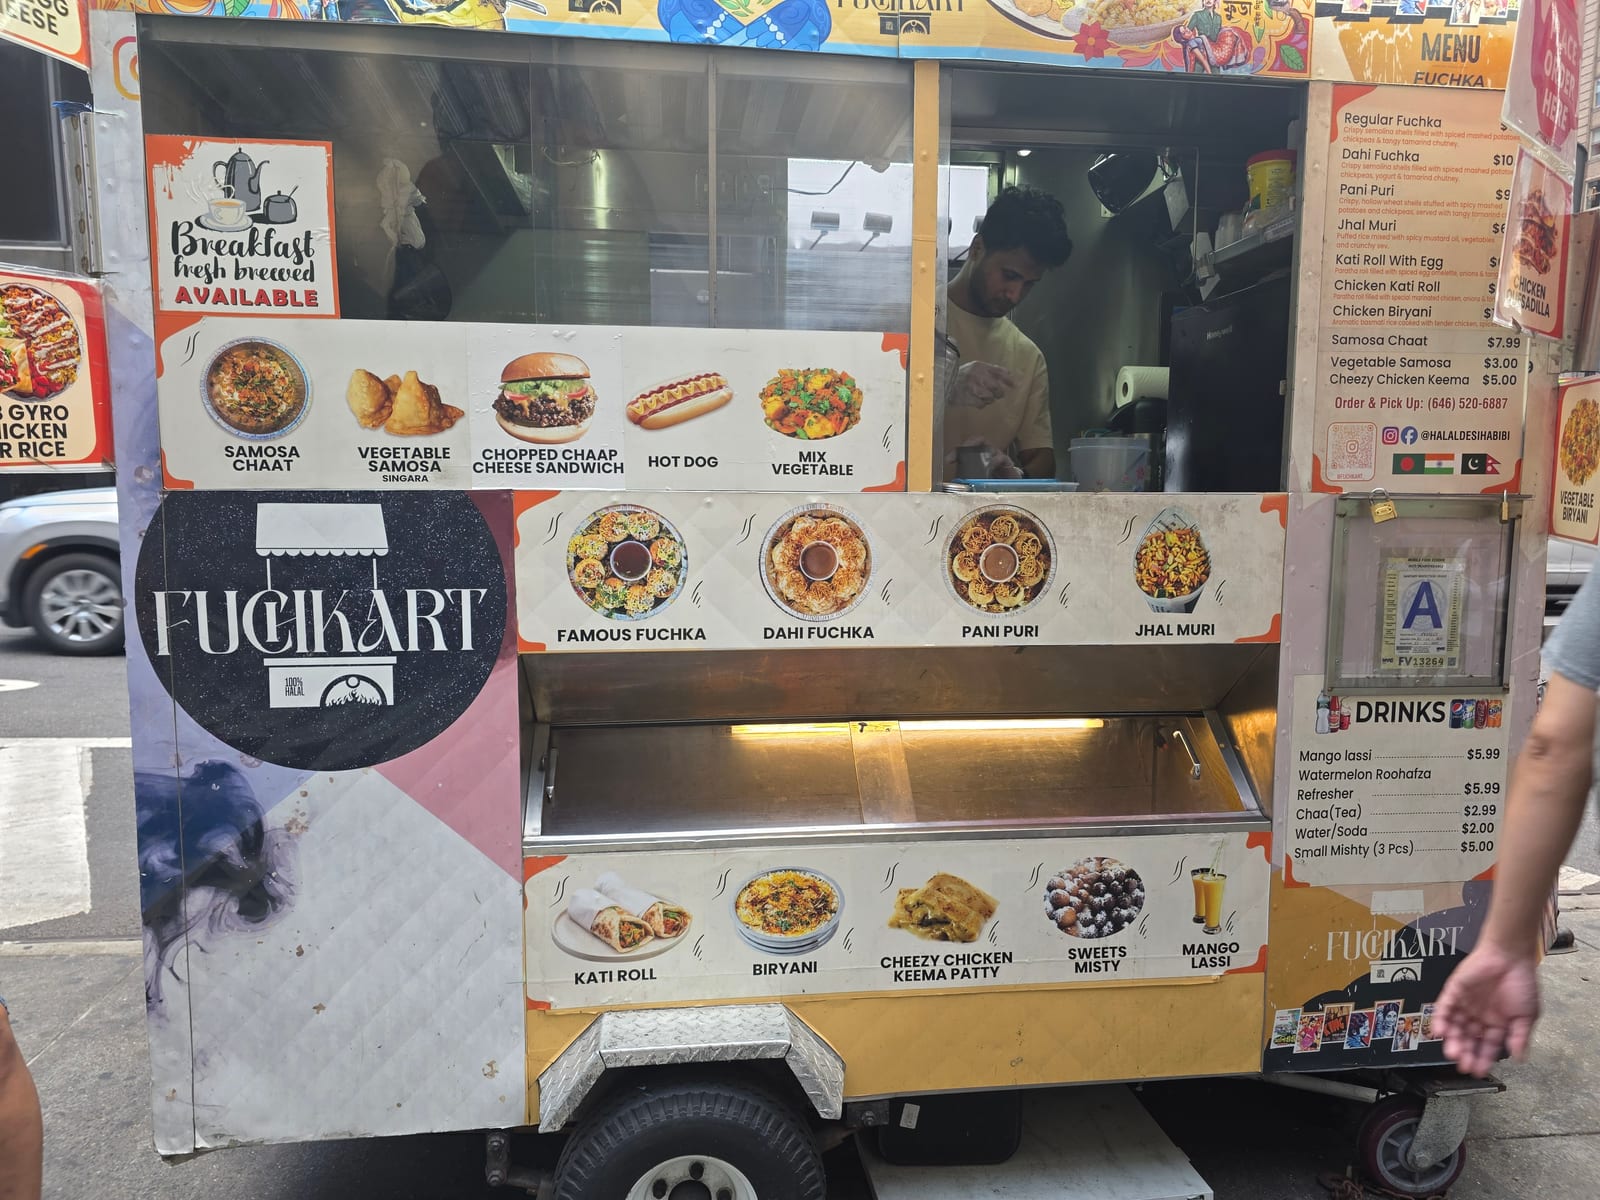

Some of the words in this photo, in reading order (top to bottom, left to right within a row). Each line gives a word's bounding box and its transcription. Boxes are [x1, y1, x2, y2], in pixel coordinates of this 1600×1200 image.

[1421, 32, 1481, 64] MENU
[1413, 71, 1485, 87] FUCHKA
[1344, 112, 1393, 128] Regular
[1396, 115, 1442, 128] Fuchka
[1430, 130, 1443, 138] with
[1342, 148, 1371, 160] Dahi
[1374, 149, 1420, 162] Fuchka
[1339, 183, 1368, 196] Pani
[1370, 184, 1395, 196] Puri
[1337, 219, 1365, 231] Jhal
[1368, 219, 1397, 231] Muri
[171, 220, 315, 265] Breakfast
[174, 254, 226, 284] fresh
[234, 258, 315, 282] brewed
[1335, 254, 1360, 265] Kati
[1363, 254, 1386, 266] Roll
[1389, 255, 1417, 266] With
[1420, 256, 1444, 270] Egg
[1334, 279, 1386, 291] Chicken
[1389, 280, 1414, 292] Kati
[1417, 281, 1440, 292] Roll
[174, 285, 319, 307] AVAILABLE
[1332, 305, 1385, 317] Chicken
[1388, 306, 1432, 320] Biryani
[1331, 334, 1384, 346] Samosa
[1388, 335, 1428, 346] Chaat
[1487, 337, 1521, 349] $7.99
[1330, 356, 1396, 371] Vegetable
[1399, 357, 1451, 369] Samosa
[1484, 357, 1518, 369] $3.00
[1329, 373, 1379, 388] Cheezy
[1381, 373, 1426, 386] Chicken
[1428, 374, 1470, 386] Keema
[1482, 373, 1517, 387] $5.00
[1335, 397, 1367, 409] Order
[1368, 398, 1376, 409] &
[1379, 397, 1403, 409] Pick
[1405, 397, 1424, 411] Up:
[1427, 397, 1456, 411] (646)
[1458, 398, 1508, 410] 520-6887
[8, 404, 69, 421] GYRO
[0, 423, 68, 440] ICKEN
[1420, 430, 1510, 442] @HALALDESIHABIBI
[18, 441, 66, 458] RICE
[224, 445, 300, 459] SAMOSA
[358, 446, 451, 460] VEGETABLE
[481, 447, 559, 462] CHOPPED
[561, 448, 618, 462] CHAAP
[648, 455, 681, 468] HOT
[683, 455, 719, 468] DOG
[798, 450, 827, 464] MIX
[232, 458, 294, 472] CHAAT
[368, 459, 442, 473] SAMOSA
[472, 461, 532, 475] CHEESE
[535, 461, 624, 475] SANDWICH
[771, 462, 854, 477] VEGETABLE
[382, 473, 429, 483] SINGARA
[1560, 490, 1595, 509] VEGETABLE
[1562, 506, 1589, 524] BIRYANI
[1402, 581, 1443, 629] A
[557, 628, 632, 642] FAMOUS
[636, 627, 707, 641] FUCHKA
[763, 626, 804, 640] DAHI
[807, 626, 875, 639] FUCHKA
[962, 625, 1000, 638] PANI
[1003, 624, 1039, 638] PURI
[1135, 624, 1173, 637] JHAL
[1176, 623, 1215, 636] MURI
[284, 677, 303, 687] 100%
[284, 687, 305, 697] HALAL
[1355, 700, 1446, 724] DRINKS
[1299, 750, 1342, 765] Mango
[1344, 749, 1372, 761] lassi
[1467, 748, 1500, 760] $5.99
[1298, 768, 1373, 781] Watermelon
[1376, 767, 1432, 780] Roohafza
[1297, 788, 1354, 801] Refresher
[1464, 782, 1500, 795] $5.99
[1296, 803, 1362, 821] Chaa(Tea)
[1464, 804, 1497, 816] $2.99
[1295, 823, 1368, 840] Water/Soda
[1461, 822, 1495, 835] $2.00
[1294, 845, 1328, 860] Small
[1331, 843, 1369, 858] Mishty
[1373, 841, 1385, 857] (3
[1388, 840, 1414, 857] Pcs)
[1460, 840, 1494, 853] $5.00
[1068, 946, 1127, 960] SWEETS
[1182, 942, 1240, 956] MANGO
[880, 954, 941, 969] CHEEZY
[943, 951, 1013, 966] CHICKEN
[1074, 959, 1121, 974] MISTY
[1191, 955, 1231, 969] LASSI
[752, 960, 818, 976] BIRYANI
[893, 967, 947, 983] KEEMA
[950, 966, 1001, 981] PATTY
[574, 970, 613, 985] KATI
[617, 968, 657, 982] ROLL
